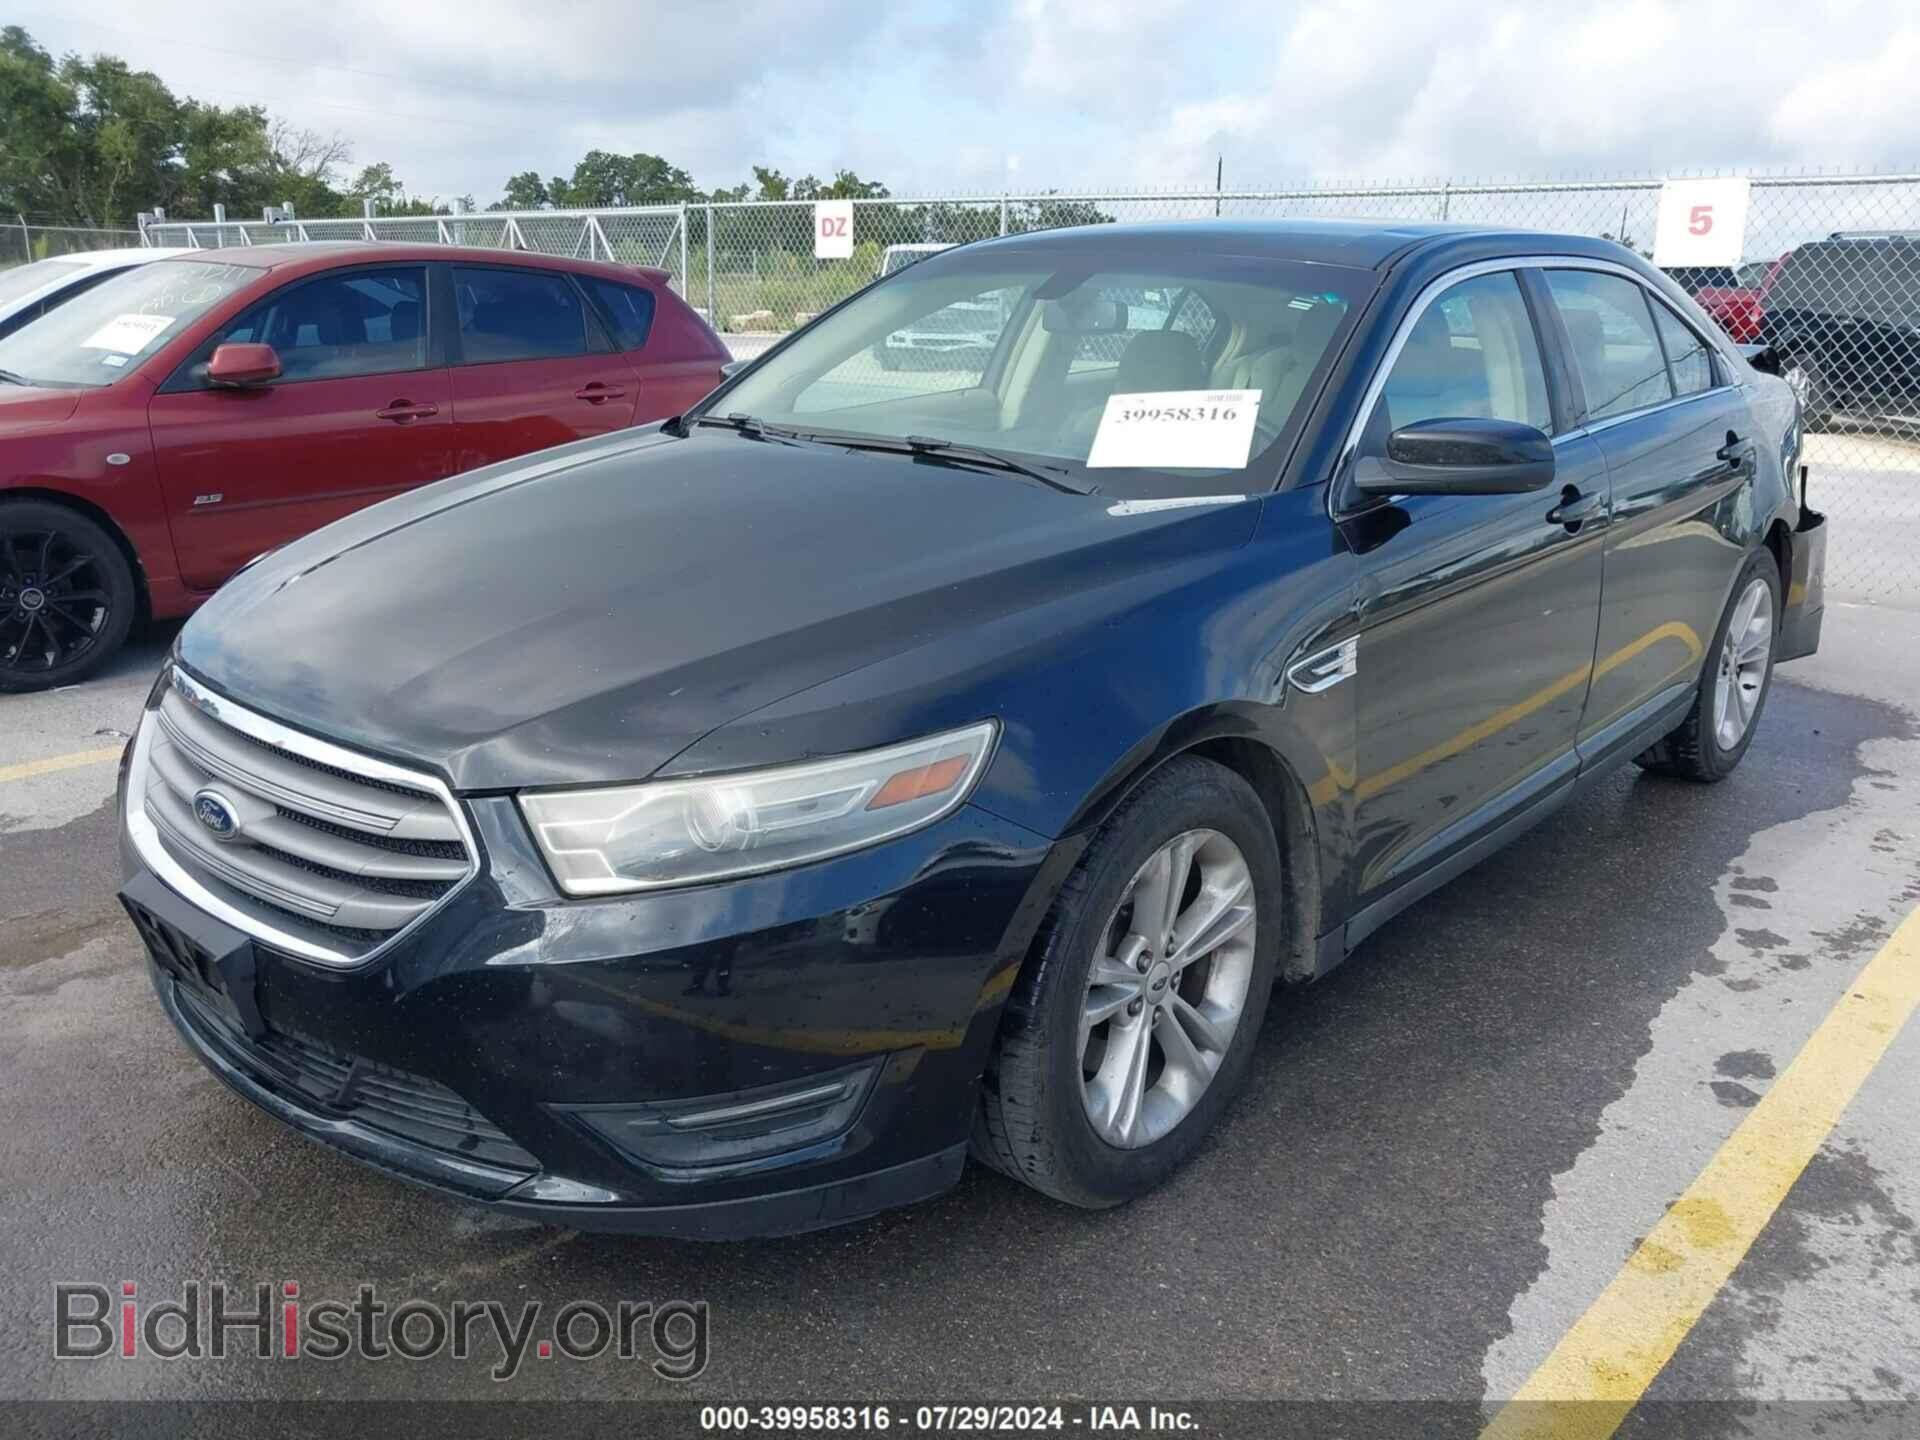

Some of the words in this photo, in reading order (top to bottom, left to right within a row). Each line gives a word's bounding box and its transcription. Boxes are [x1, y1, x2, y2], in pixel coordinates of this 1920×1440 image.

[822, 217, 847, 237] DZ
[1688, 206, 1713, 236] 5
[1115, 407, 1237, 423] 39958316
[200, 799, 225, 828] Ford
